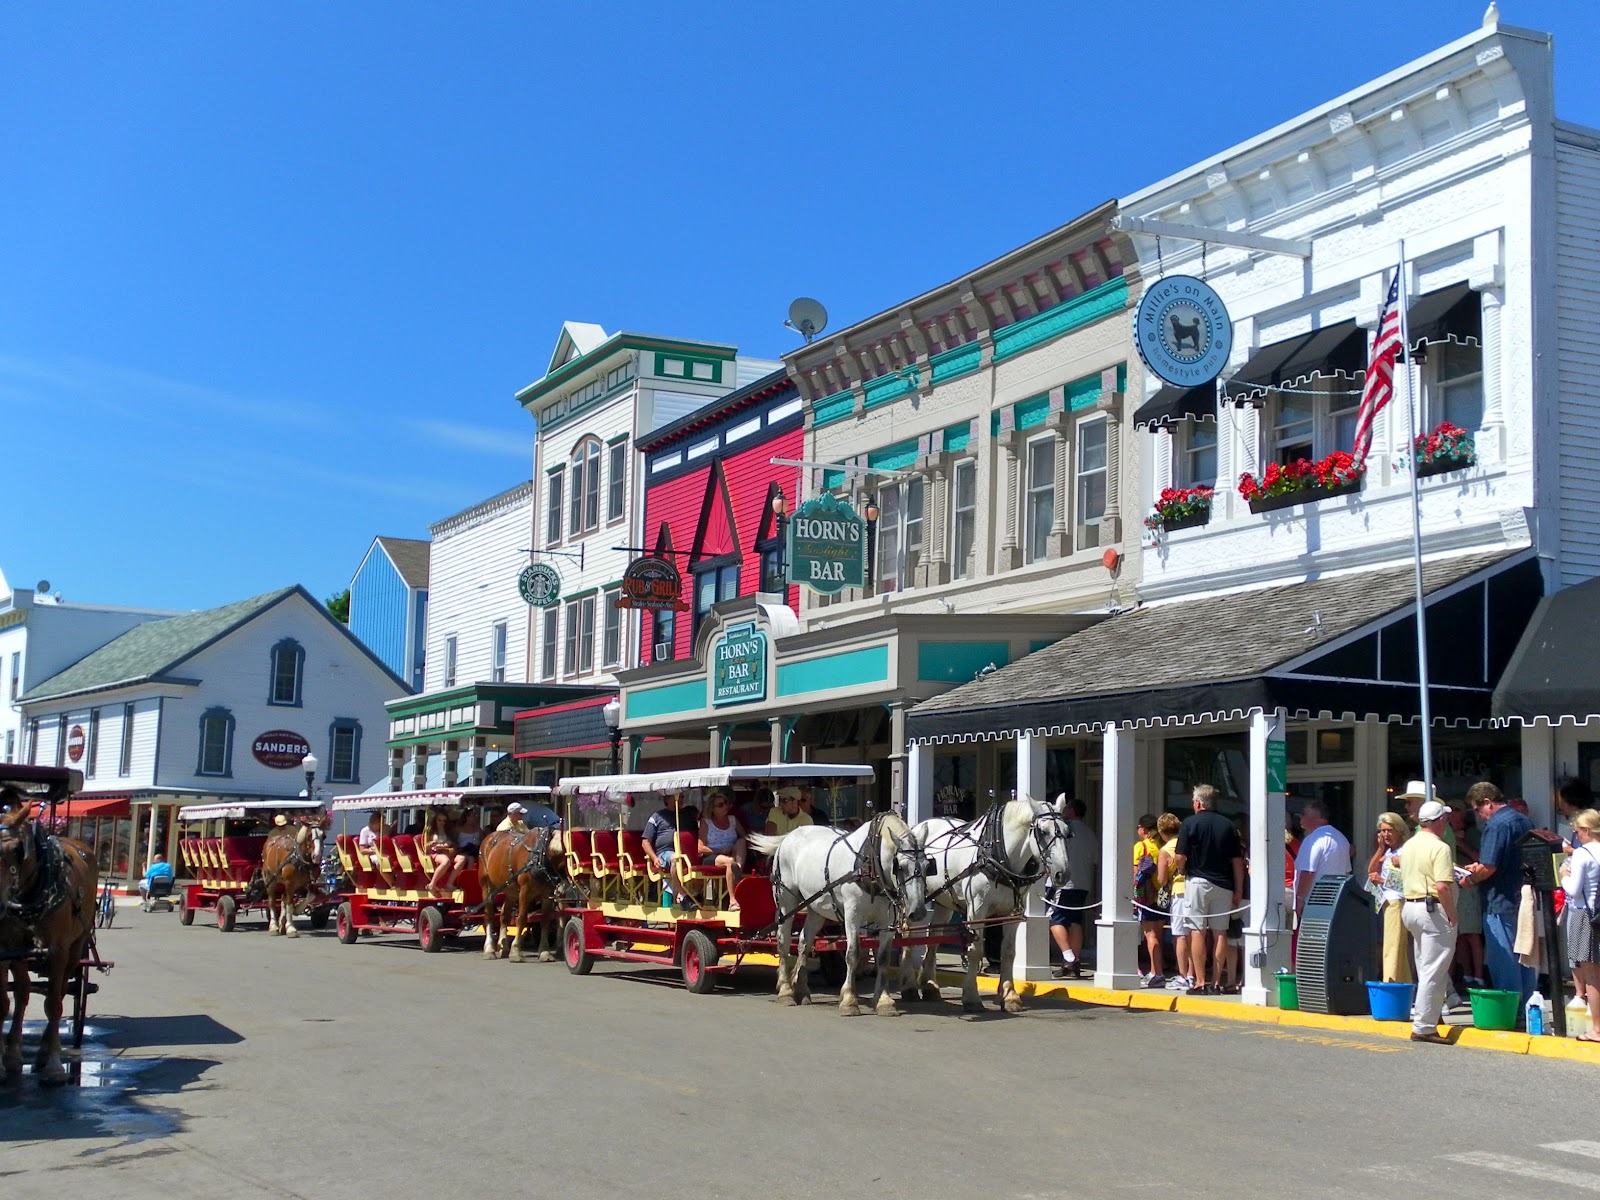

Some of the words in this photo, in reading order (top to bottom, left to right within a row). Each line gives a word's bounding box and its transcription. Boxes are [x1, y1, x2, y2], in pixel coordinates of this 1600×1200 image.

[1145, 283, 1179, 324] Millie's
[1185, 285, 1200, 298] on
[1203, 296, 1223, 330] Main
[1152, 347, 1200, 379] homestyle
[1203, 354, 1218, 372] pub
[796, 518, 860, 542] HORN'S
[521, 565, 559, 586] STARBUCKS
[809, 560, 846, 581] BAR
[524, 592, 553, 606] COFFEE
[720, 640, 758, 660] HORN'S
[728, 663, 749, 679] BAR
[717, 682, 759, 697] RESTAURANT
[255, 742, 308, 754] SANDERS
[937, 785, 965, 803] HORN'S
[943, 804, 958, 815] BAR
